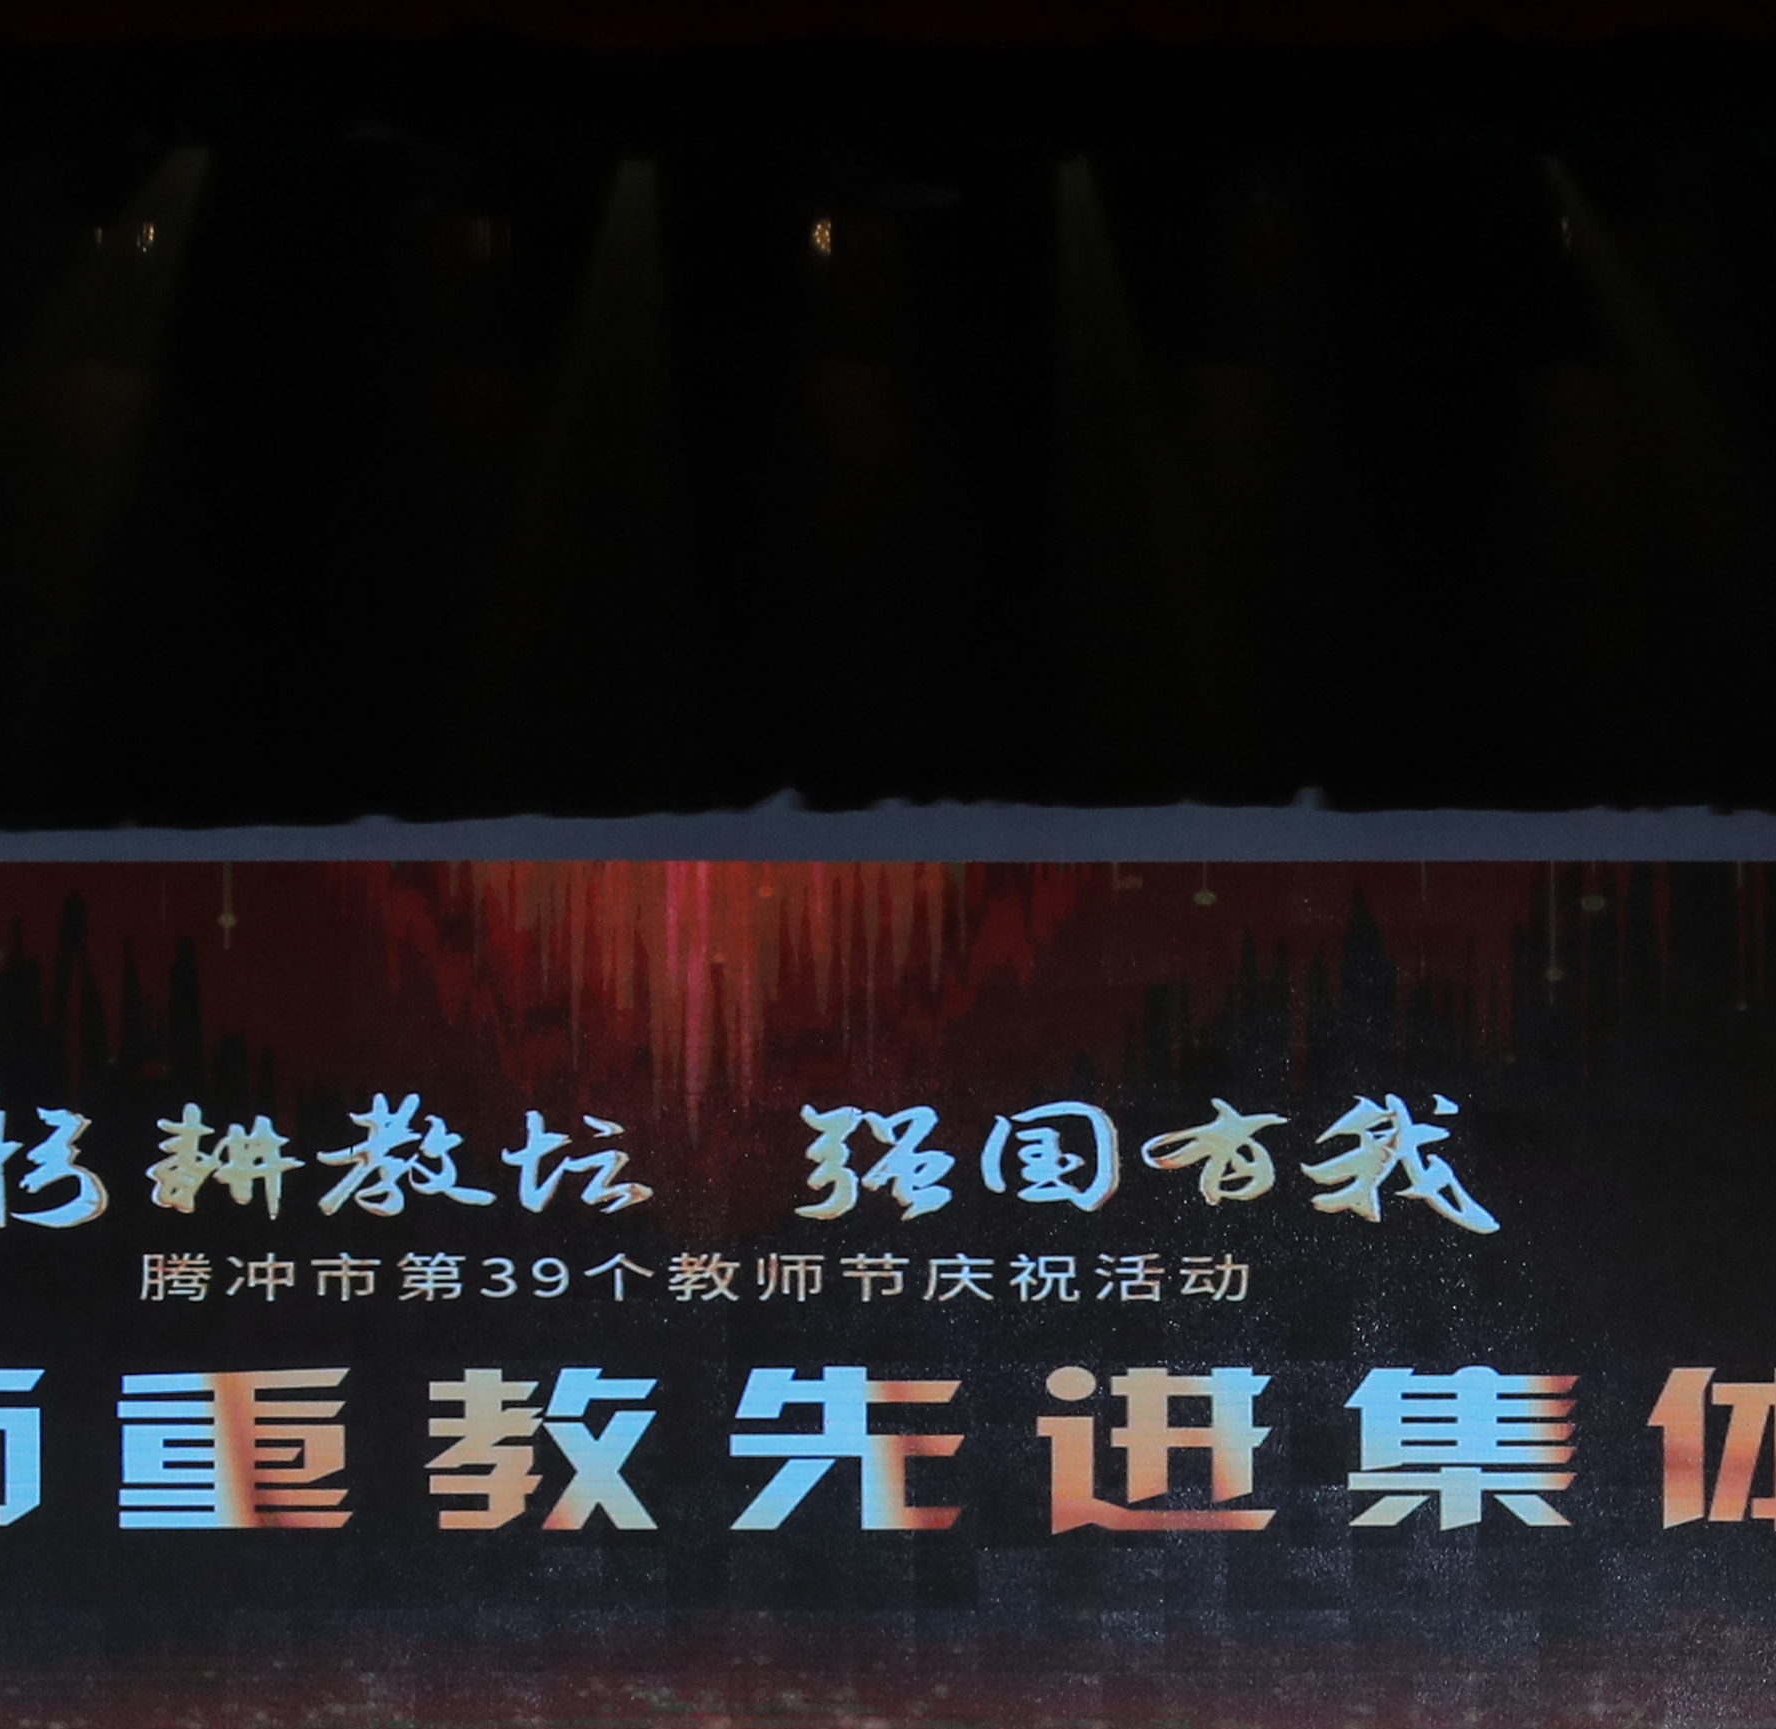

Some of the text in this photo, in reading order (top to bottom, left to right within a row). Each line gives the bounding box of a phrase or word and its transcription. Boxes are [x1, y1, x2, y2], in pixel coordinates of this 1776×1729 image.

[788, 1090, 1503, 1238] 强国有我
[139, 1248, 1254, 1307] 腾冲市第39个教师节庆祝活动
